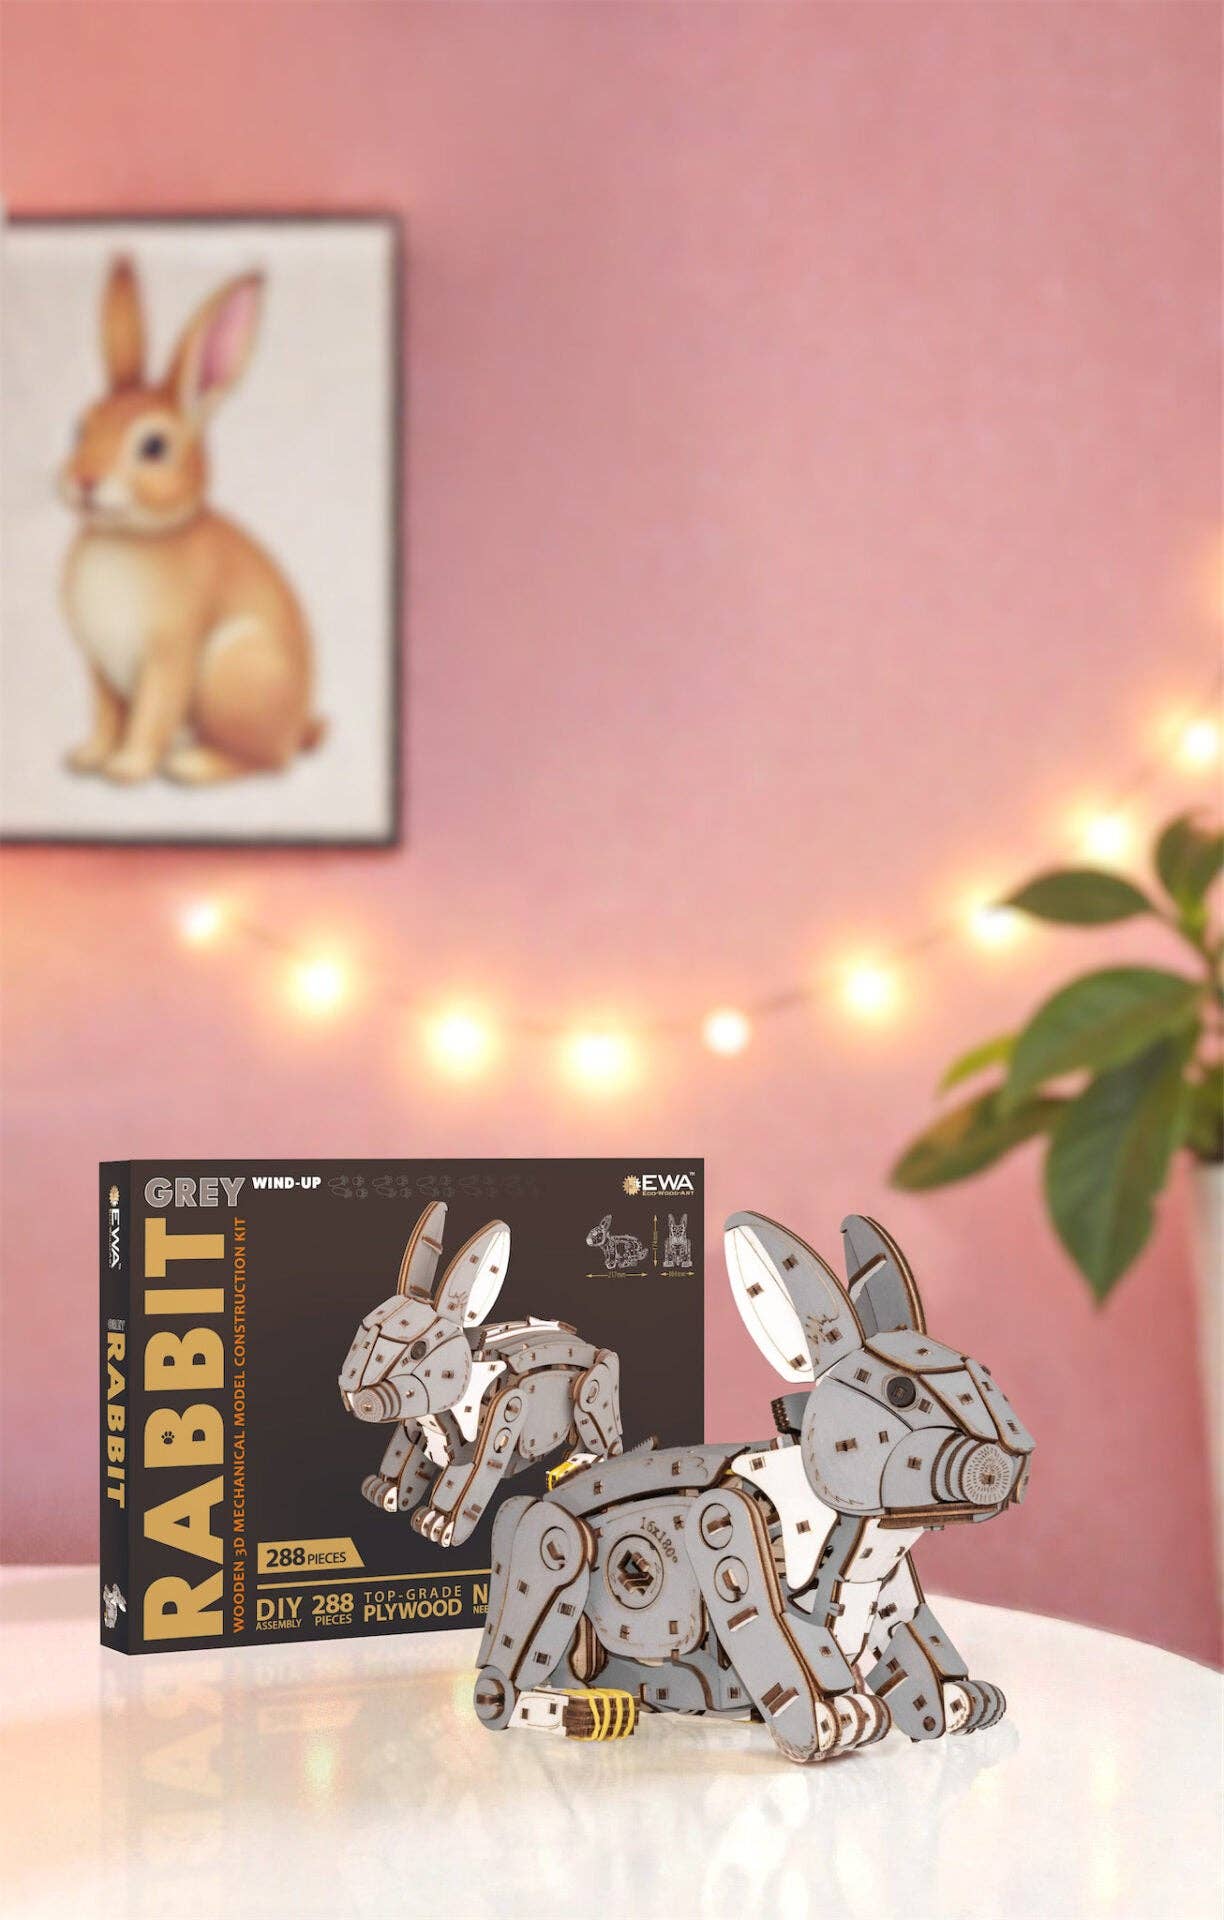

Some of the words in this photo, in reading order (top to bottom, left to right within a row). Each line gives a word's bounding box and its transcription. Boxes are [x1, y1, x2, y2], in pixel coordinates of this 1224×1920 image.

[144, 1176, 246, 1209] GREY
[252, 1176, 322, 1190] WIND-UP
[233, 1217, 246, 1241] KIT
[233, 1246, 246, 1366] CONSTRUCTION
[233, 1370, 246, 1427] MODEL
[107, 1331, 126, 1509] RABBIT
[143, 1217, 225, 1641] RABBIT
[233, 1431, 246, 1532] MECHANICAL
[233, 1537, 247, 1556] 3D
[266, 1547, 306, 1569] 288
[307, 1551, 347, 1566] PIECES
[232, 1560, 245, 1633] WOODEN
[364, 1585, 463, 1604] TOP-GRADE
[473, 1583, 488, 1605] N
[256, 1596, 303, 1622] DIY
[311, 1593, 355, 1616] 288
[363, 1598, 463, 1622] PLYWOOD
[473, 1604, 489, 1615] NEE
[255, 1618, 302, 1631] ASSEMBLY
[314, 1613, 352, 1627] PIECES
